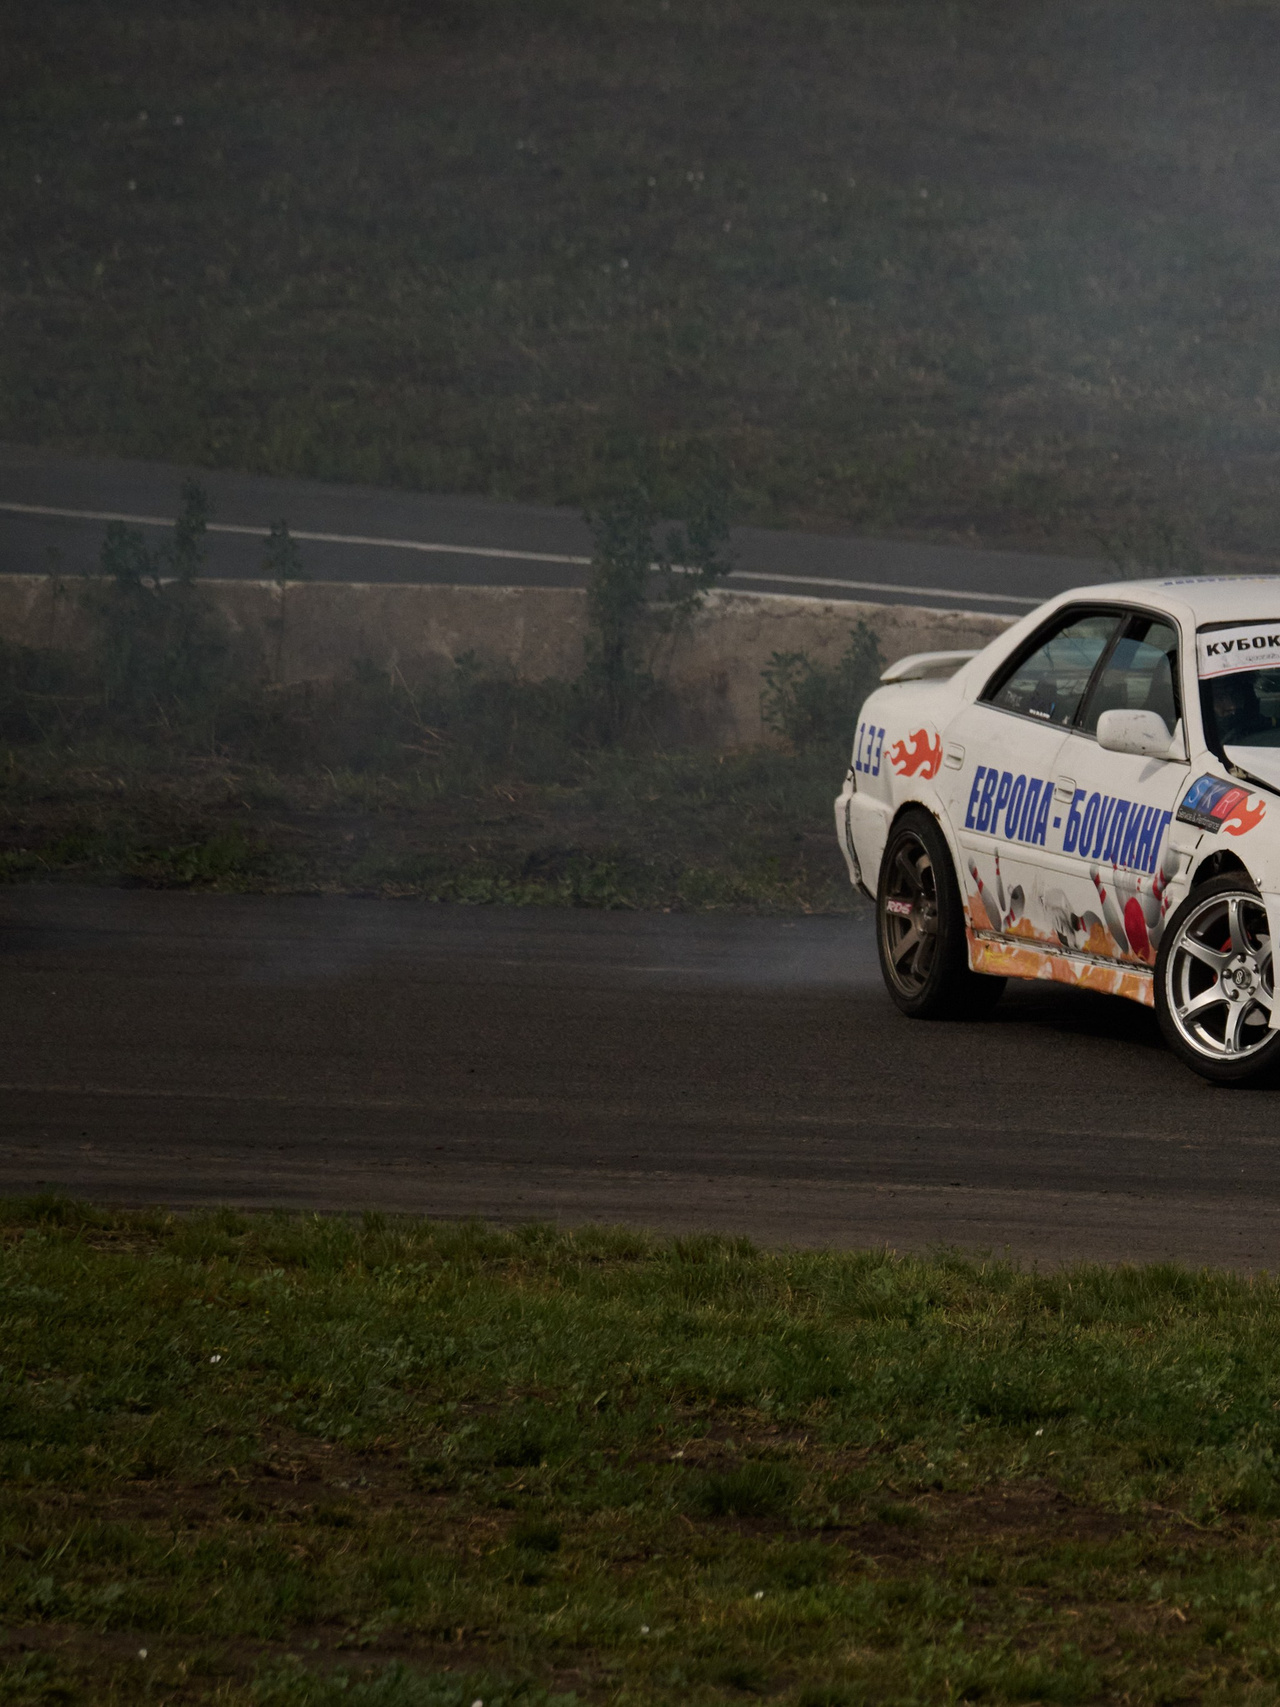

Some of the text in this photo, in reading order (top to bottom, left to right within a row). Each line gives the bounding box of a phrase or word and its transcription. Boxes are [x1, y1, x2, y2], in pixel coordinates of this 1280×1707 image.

[855, 722, 886, 777] 133
[964, 765, 1055, 847] ЕВРОПА
[1062, 788, 1174, 874] БОУЛИНГ
[1188, 779, 1240, 814] SKR
